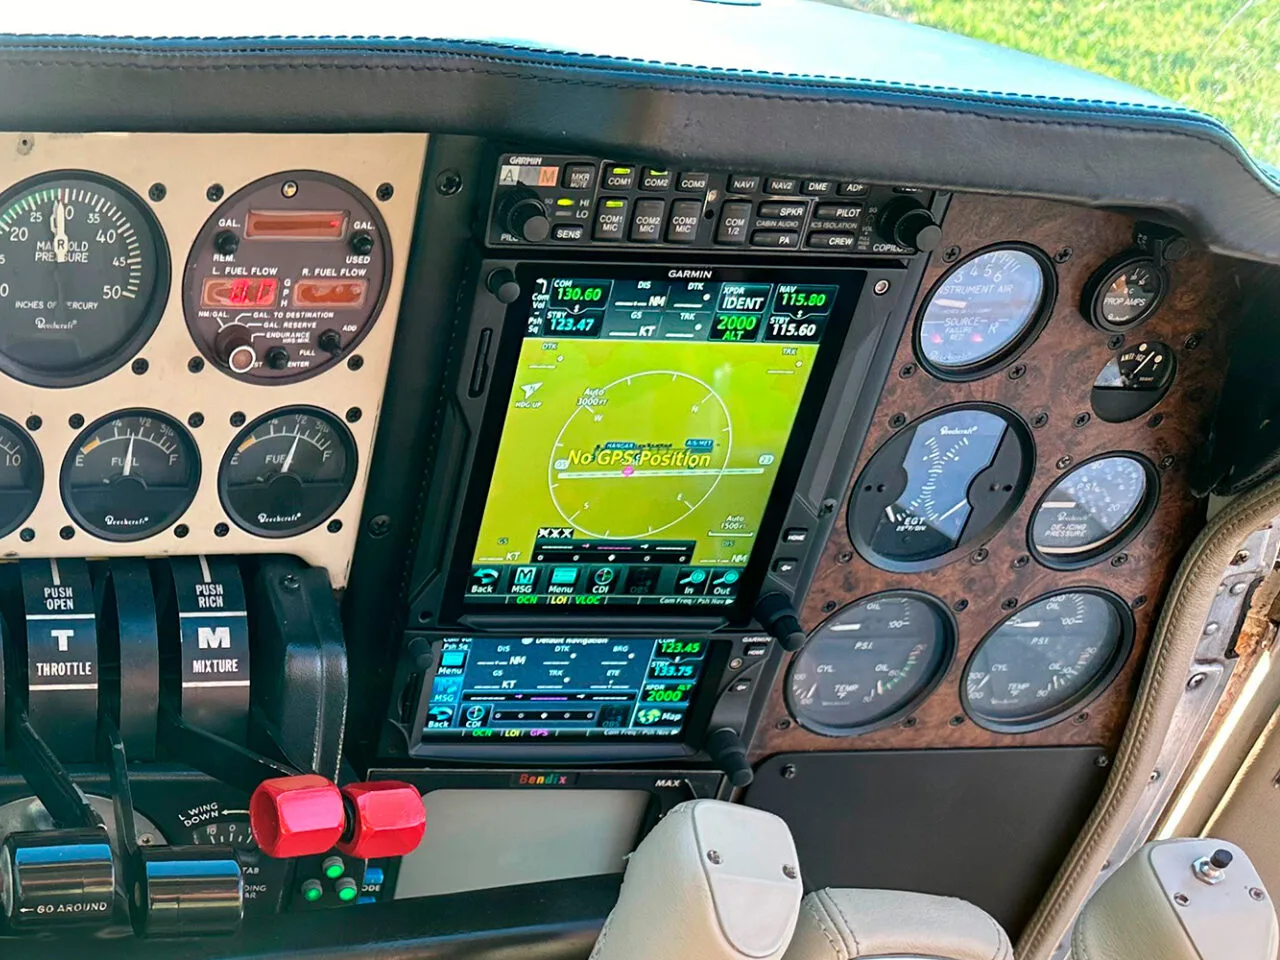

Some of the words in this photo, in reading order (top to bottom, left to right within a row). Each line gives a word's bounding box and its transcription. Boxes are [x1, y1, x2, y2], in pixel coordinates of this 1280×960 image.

[510, 157, 542, 165] GARMIN
[608, 177, 630, 185] COM1
[645, 179, 668, 187] COM2
[682, 180, 704, 188] COM3
[734, 181, 754, 189] NAV1
[809, 183, 828, 191] DME
[780, 208, 803, 216] SPKR
[836, 209, 861, 217] PILOT
[557, 230, 581, 238] SENS
[829, 237, 853, 246] CREW
[346, 256, 370, 264] USED
[251, 267, 278, 275] FLOW
[668, 270, 712, 278] GARMIN
[103, 286, 121, 299] 50
[558, 288, 602, 300] 130.60
[722, 297, 764, 309] IDENT
[782, 294, 826, 305] 115.80
[551, 318, 594, 330] 123.47
[717, 316, 756, 330] 2000
[639, 326, 656, 336] KT
[722, 331, 743, 340] ALT
[773, 324, 816, 336] 115.60
[568, 449, 591, 465] No
[597, 451, 631, 466] GPS
[638, 451, 711, 467] Position
[44, 587, 72, 598] PUSH
[196, 584, 223, 595] PUSH
[471, 584, 493, 593] Back
[511, 585, 532, 593] MSG
[548, 585, 573, 594] Menu
[592, 585, 609, 593] CDI
[47, 599, 74, 610] OPEN
[199, 596, 223, 608] RICH
[51, 630, 74, 651] T
[198, 627, 230, 649] M
[661, 643, 700, 652] 123.45
[36, 662, 92, 676] THROTTLE
[193, 659, 238, 673] MIXTURE
[654, 666, 693, 675] 133.75
[662, 713, 682, 721] Map
[520, 774, 567, 785] Bendix
[655, 779, 680, 787] MAX
[187, 802, 218, 816] WING
[184, 810, 219, 827] DOWN
[37, 905, 54, 914] GO
[58, 902, 107, 913] AROUND
